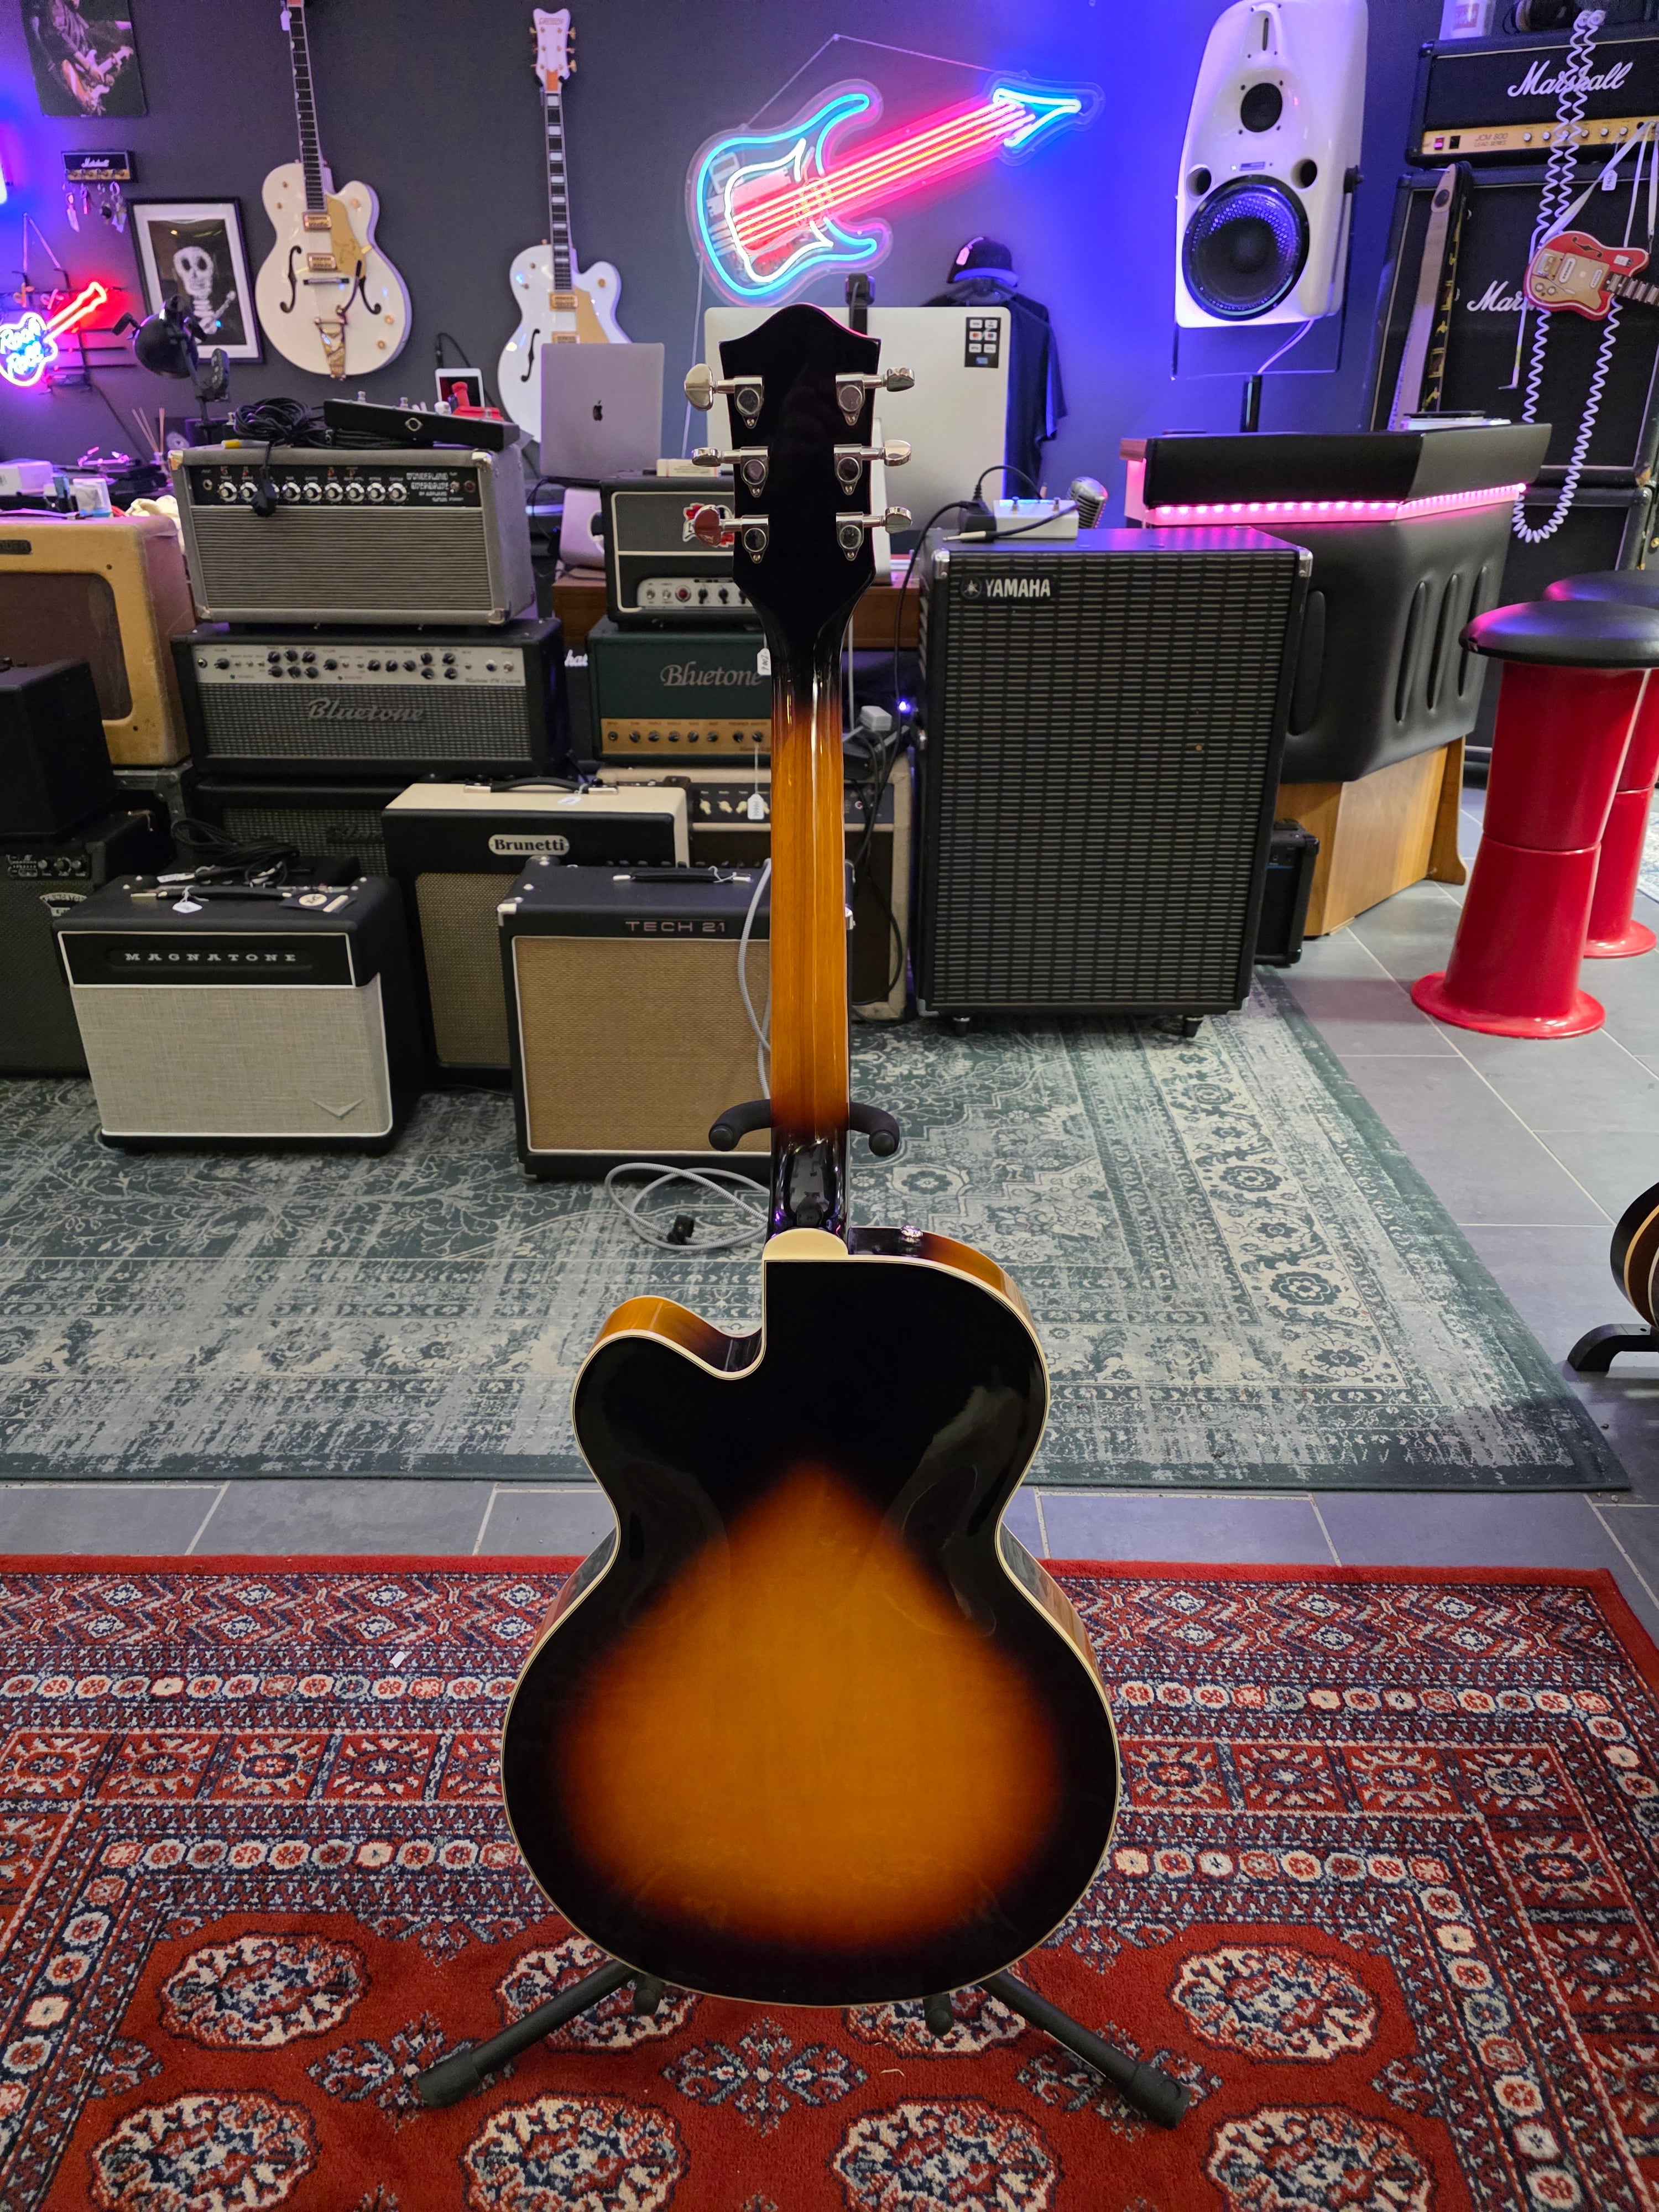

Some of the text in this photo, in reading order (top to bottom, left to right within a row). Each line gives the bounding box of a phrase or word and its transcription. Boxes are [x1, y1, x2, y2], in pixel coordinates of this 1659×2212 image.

[1507, 60, 1633, 97] Marshall
[985, 578, 1051, 597] YAMAHA
[660, 661, 763, 686] Bluetone
[309, 698, 424, 721] Bluetone
[494, 838, 565, 851] Brunetti
[625, 921, 726, 932] TECH 21
[124, 953, 296, 962] MAGNATONE
